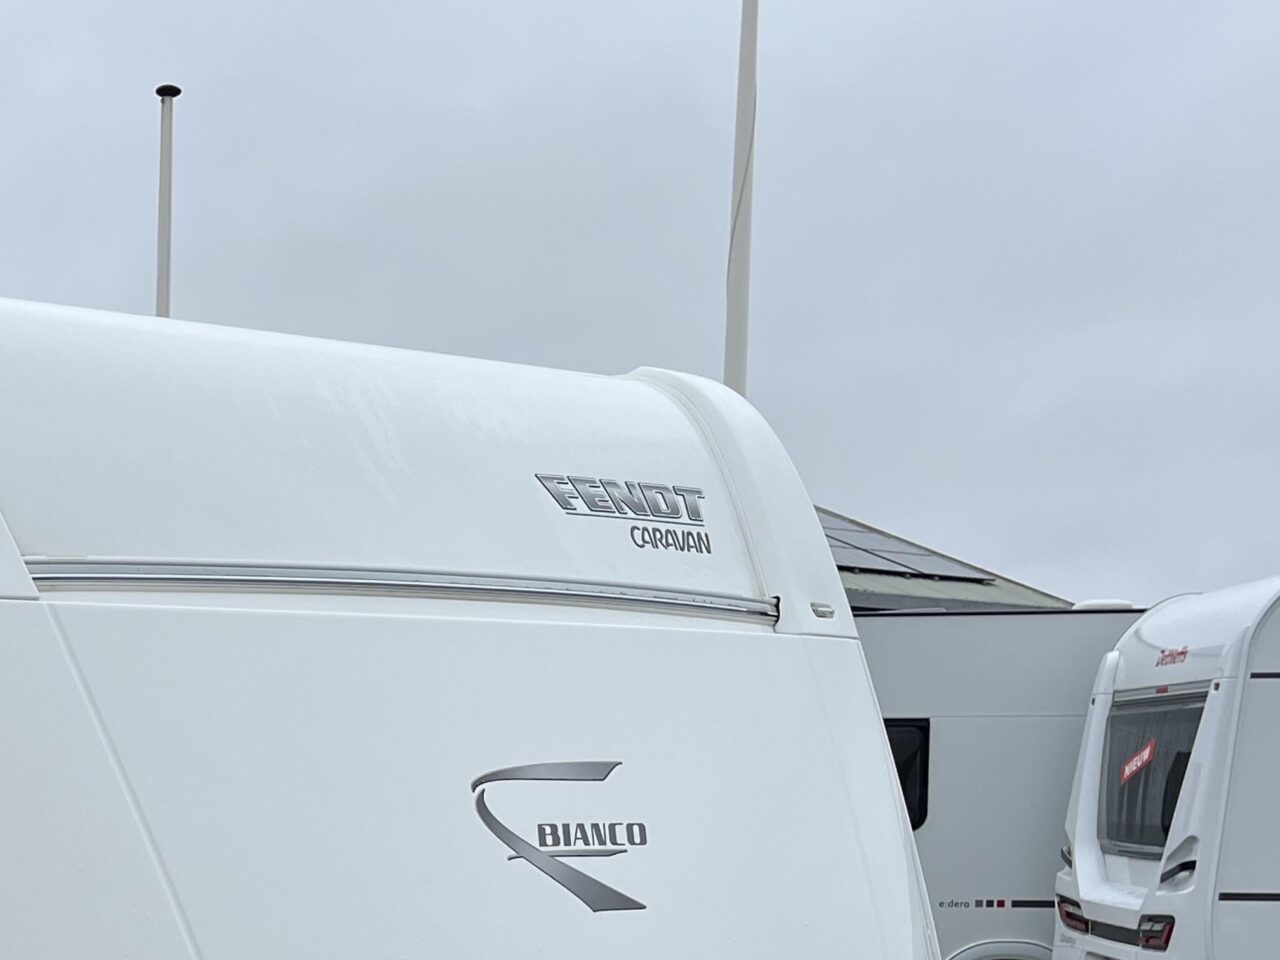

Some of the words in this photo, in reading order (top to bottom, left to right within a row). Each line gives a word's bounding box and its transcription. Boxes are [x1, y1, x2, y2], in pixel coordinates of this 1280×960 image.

[534, 473, 705, 522] FENDT
[630, 525, 712, 554] CARAVAN
[1124, 746, 1151, 778] NIEUW
[537, 822, 648, 848] BIANCO
